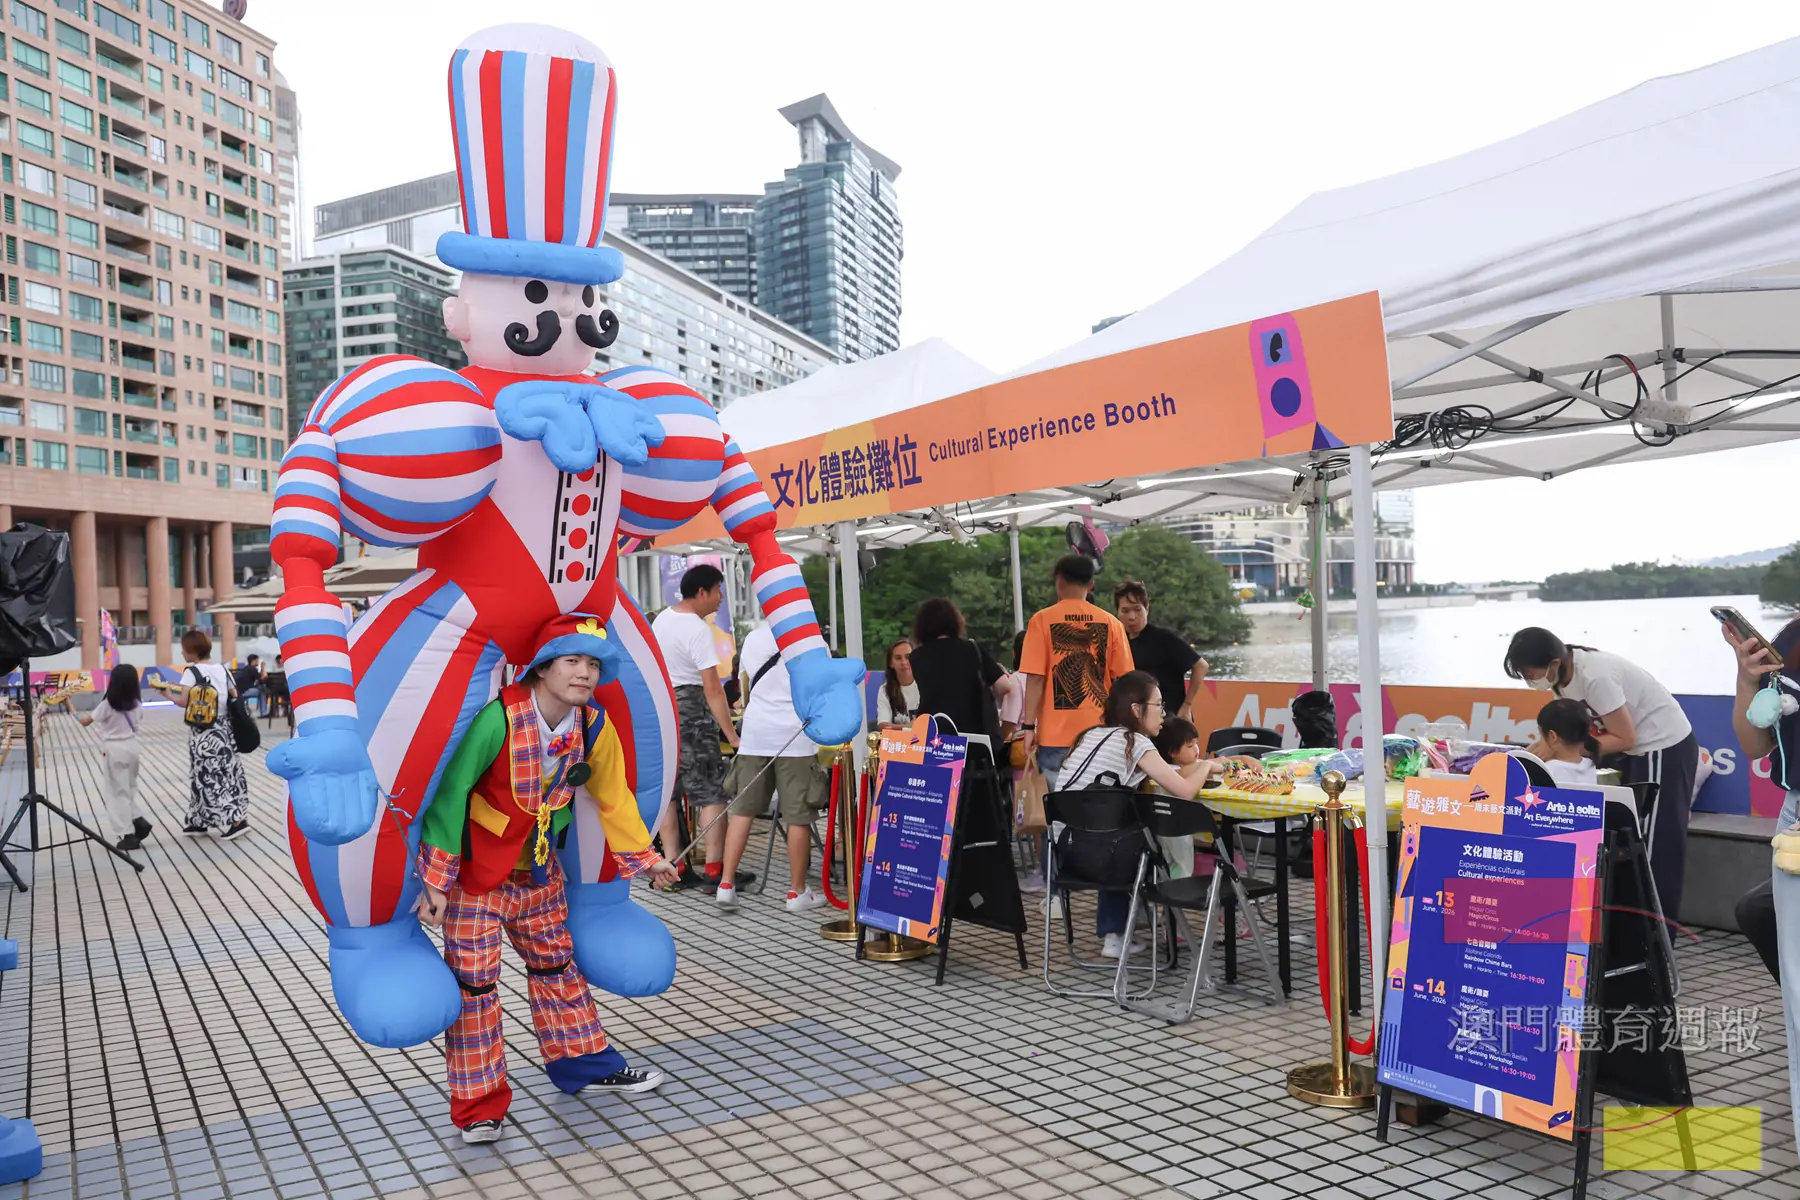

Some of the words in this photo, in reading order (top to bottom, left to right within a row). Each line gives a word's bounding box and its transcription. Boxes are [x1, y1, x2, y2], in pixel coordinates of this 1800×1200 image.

[929, 431, 984, 462] Cultural
[987, 412, 1096, 450] Experience
[1104, 392, 1177, 427] Booth
[771, 434, 922, 508] 文化體驗攤位
[1546, 801, 1567, 812] Arte
[1568, 802, 1575, 813] à
[1576, 804, 1600, 816] solta
[889, 812, 898, 823] 13
[1535, 813, 1574, 825] Everywhere
[1463, 844, 1524, 863] 文化體驗活動
[882, 861, 891, 873] 14
[1459, 860, 1496, 872] Experiências
[1498, 866, 1525, 876] culturais
[1458, 869, 1483, 879] Cultural
[1485, 874, 1524, 885] experiences
[1435, 890, 1455, 908] 13
[1441, 907, 1456, 916] 2026
[1464, 954, 1484, 963] Rainbow
[1485, 958, 1500, 967] Chime
[1501, 961, 1512, 969] Bars
[1510, 971, 1545, 985] 16:30-19:00
[1426, 977, 1446, 996] 14
[1432, 995, 1447, 1005] 2026
[1468, 1048, 1488, 1060] Spinning
[1489, 1053, 1513, 1066] Workshop
[1501, 1065, 1536, 1081] 16:30-19:00
